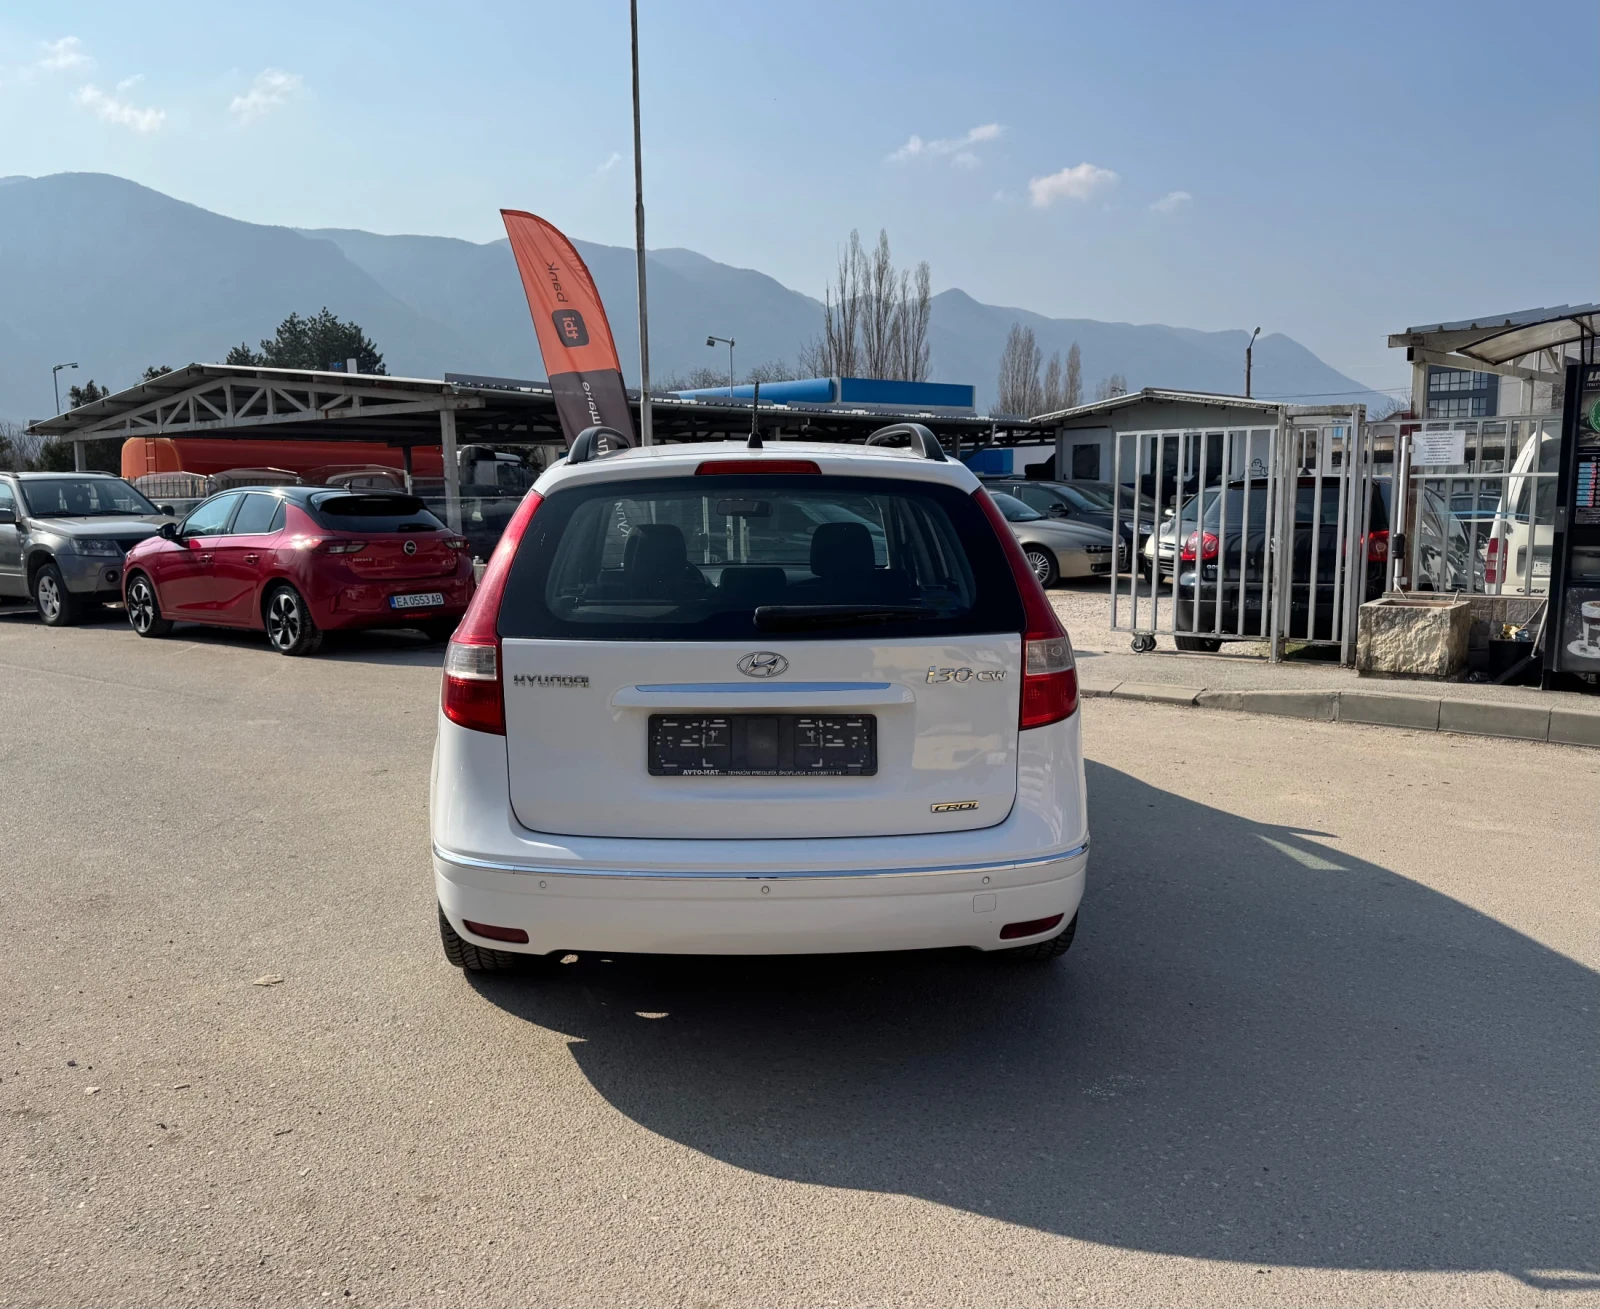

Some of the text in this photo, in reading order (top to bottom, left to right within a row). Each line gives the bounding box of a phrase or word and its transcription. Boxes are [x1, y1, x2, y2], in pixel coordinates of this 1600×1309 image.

[395, 597, 409, 607] EA
[410, 595, 430, 605] 0553
[431, 594, 443, 604] AB
[513, 674, 589, 688] HYUNDAI
